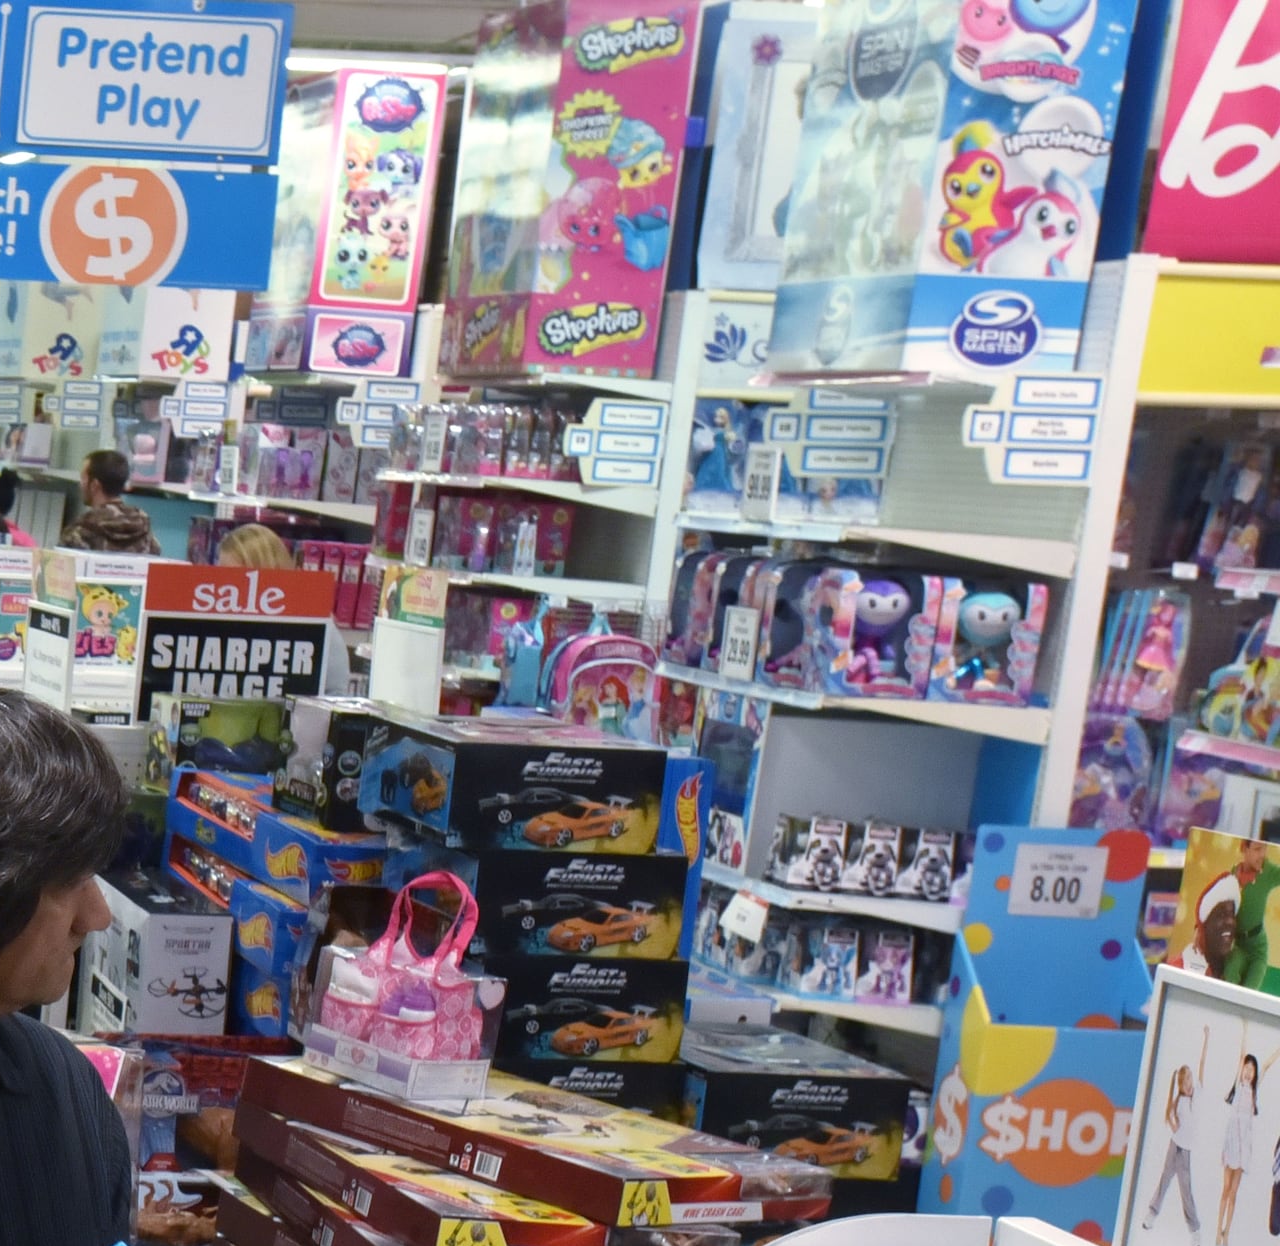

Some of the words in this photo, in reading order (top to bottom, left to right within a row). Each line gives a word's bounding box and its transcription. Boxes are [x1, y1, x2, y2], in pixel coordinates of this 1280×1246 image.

[57, 27, 249, 77] Pretend
[579, 18, 681, 62] Shopkins
[96, 83, 201, 140] Play
[543, 304, 641, 346] Shopkins
[963, 327, 1027, 346] SPIN
[962, 340, 1026, 356] MASTER
[192, 570, 286, 615] sale
[151, 634, 316, 676] SHARPER
[1030, 875, 1081, 904] 8.00
[682, 1208, 698, 1218] WWE
[698, 1207, 725, 1218] CRASH
[726, 1207, 747, 1217] CAGE
